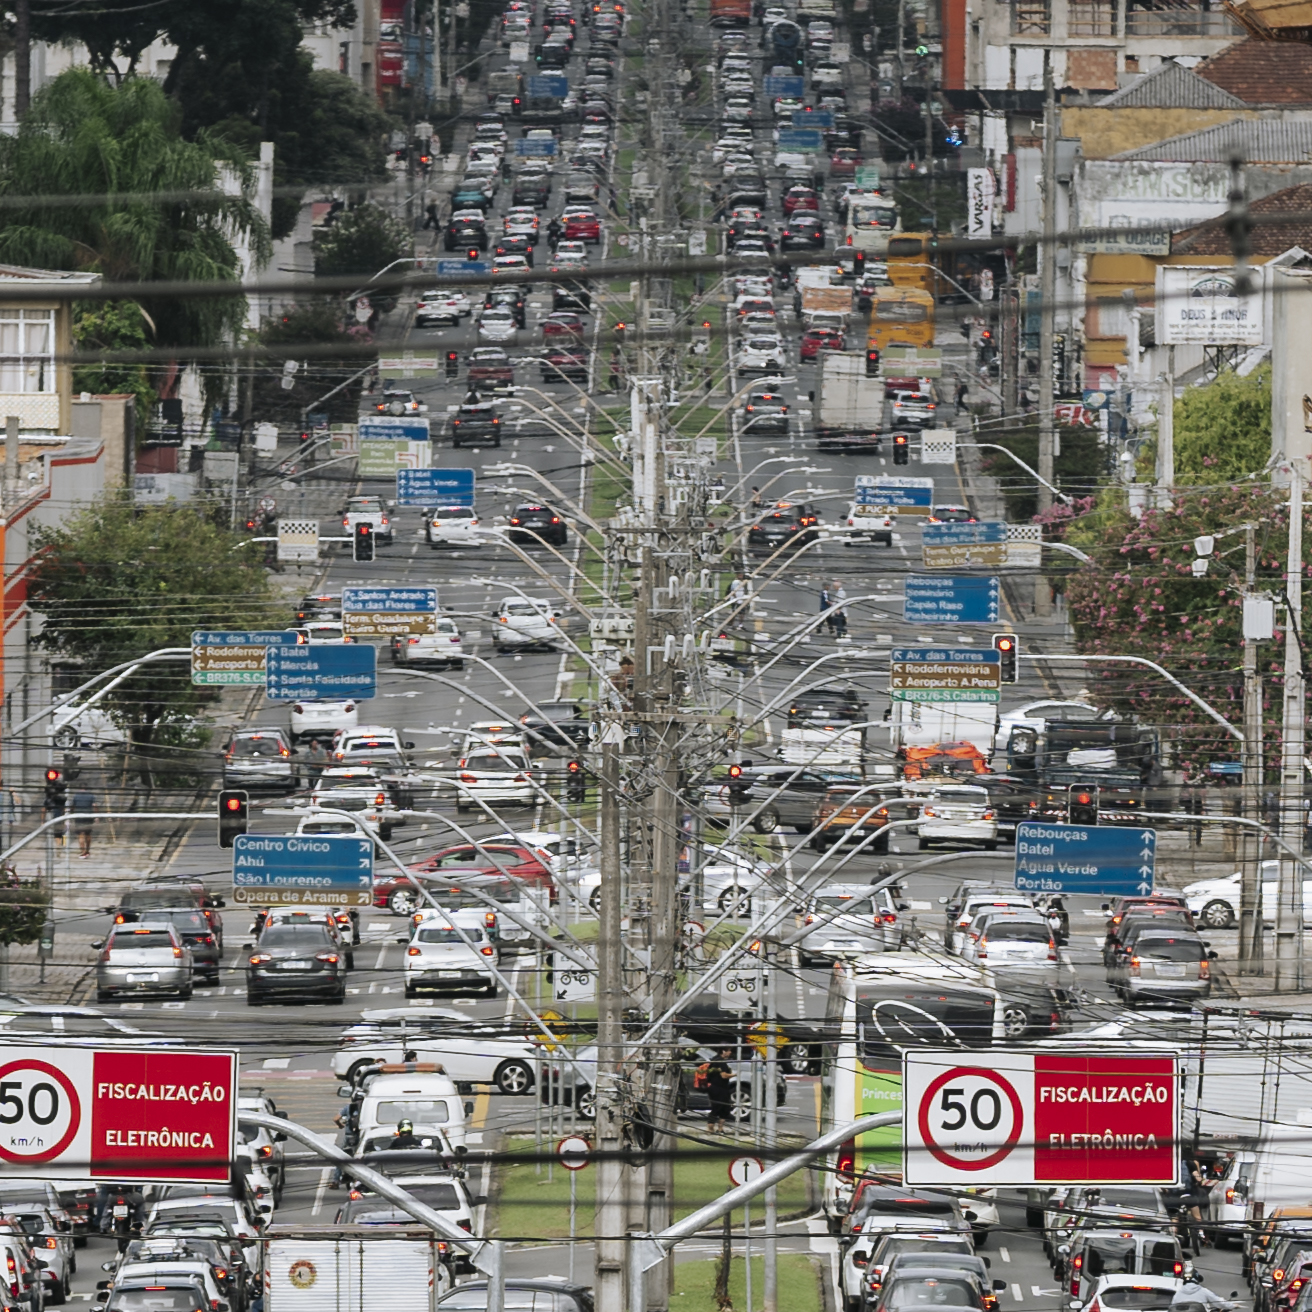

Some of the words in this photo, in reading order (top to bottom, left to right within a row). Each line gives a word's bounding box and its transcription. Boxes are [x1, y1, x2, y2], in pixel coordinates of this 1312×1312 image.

[972, 173, 985, 233] VARGAS
[281, 648, 309, 656] Batel
[905, 651, 922, 660] Av.
[925, 651, 946, 660] das
[947, 651, 984, 661] Torres
[905, 664, 990, 674] Rodoferroviária
[905, 677, 958, 688] Aeroporto
[280, 687, 318, 697] Portão
[1019, 826, 1088, 842] Rebouças
[237, 838, 284, 851] Centro
[288, 839, 330, 852] Cívico
[1019, 842, 1054, 855] Batel
[236, 855, 265, 867] Ahú
[1018, 858, 1054, 874] Água
[1057, 862, 1098, 875] Verde
[236, 873, 263, 885] São
[266, 873, 332, 888] Lourenço
[1016, 877, 1063, 890] Portão
[236, 888, 279, 903] Ópera
[282, 891, 300, 901] de
[302, 891, 348, 903] Arame
[98, 1081, 225, 1105] FISCALIZAÇÃO
[1040, 1082, 1168, 1107] FISCALIZAÇÃO
[940, 1088, 1002, 1131] 50
[10, 1136, 43, 1147] km/h
[105, 1126, 214, 1148] ELETRÔNICA
[1049, 1128, 1159, 1151] ELETRÔNICA
[954, 1141, 988, 1154] km/h
